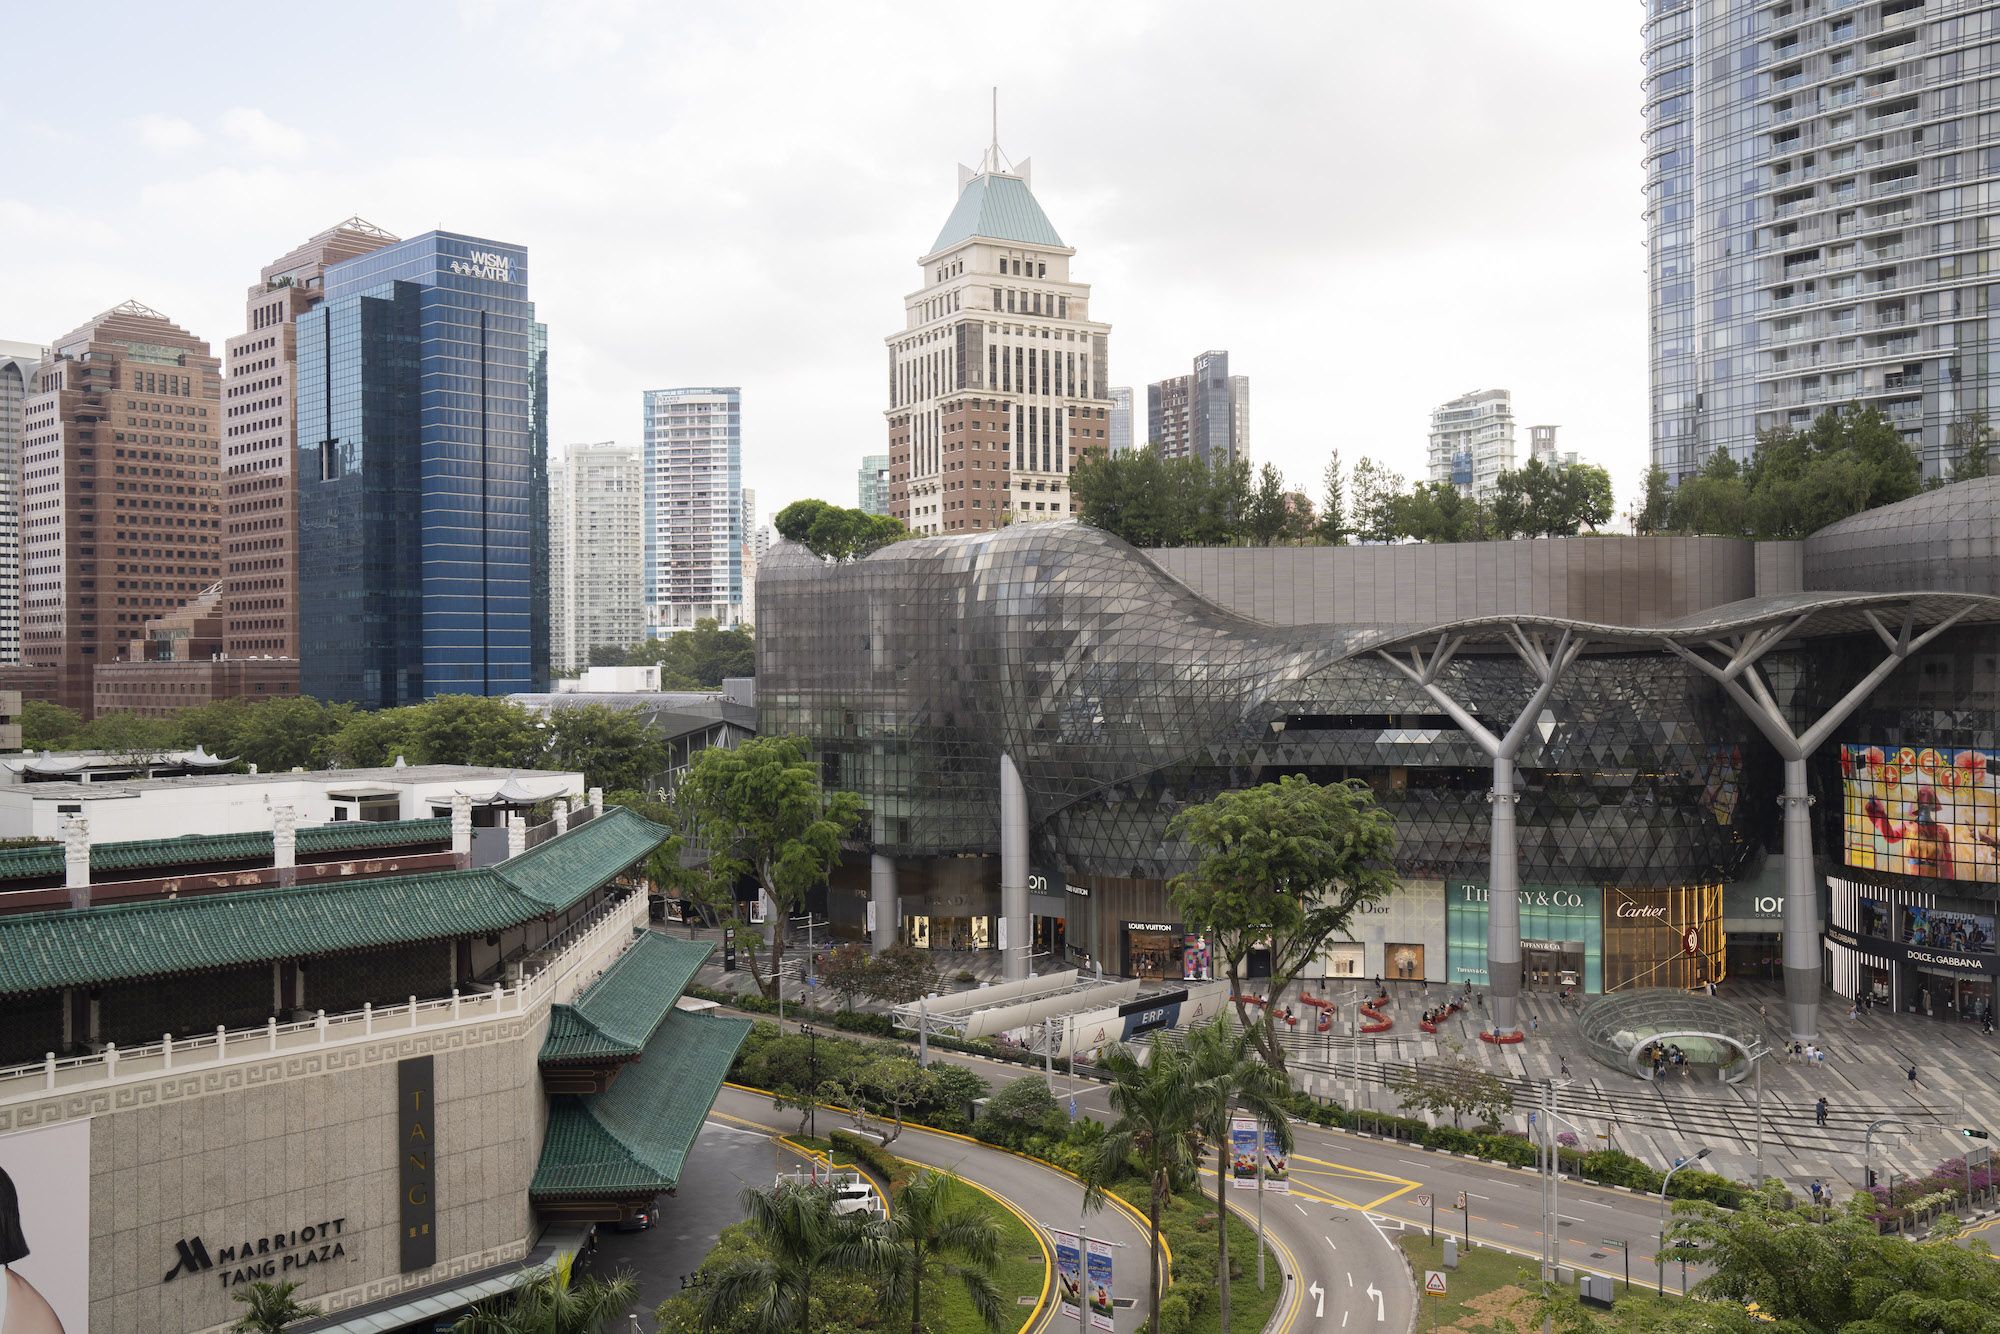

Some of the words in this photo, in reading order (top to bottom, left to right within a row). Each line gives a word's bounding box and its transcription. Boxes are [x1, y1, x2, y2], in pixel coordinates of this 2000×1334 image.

[470, 250, 517, 271] WISMA
[1360, 900, 1391, 914] Dior
[1616, 901, 1667, 918] Cartier
[1907, 950, 1931, 963] DOLCE
[1936, 955, 1983, 969] GABBANA
[1142, 1009, 1164, 1024] ERP
[408, 1088, 427, 1206] TANG
[219, 1218, 345, 1264] MARRIOTT
[219, 1259, 276, 1288] TANG
[283, 1243, 345, 1271] PLAZA
